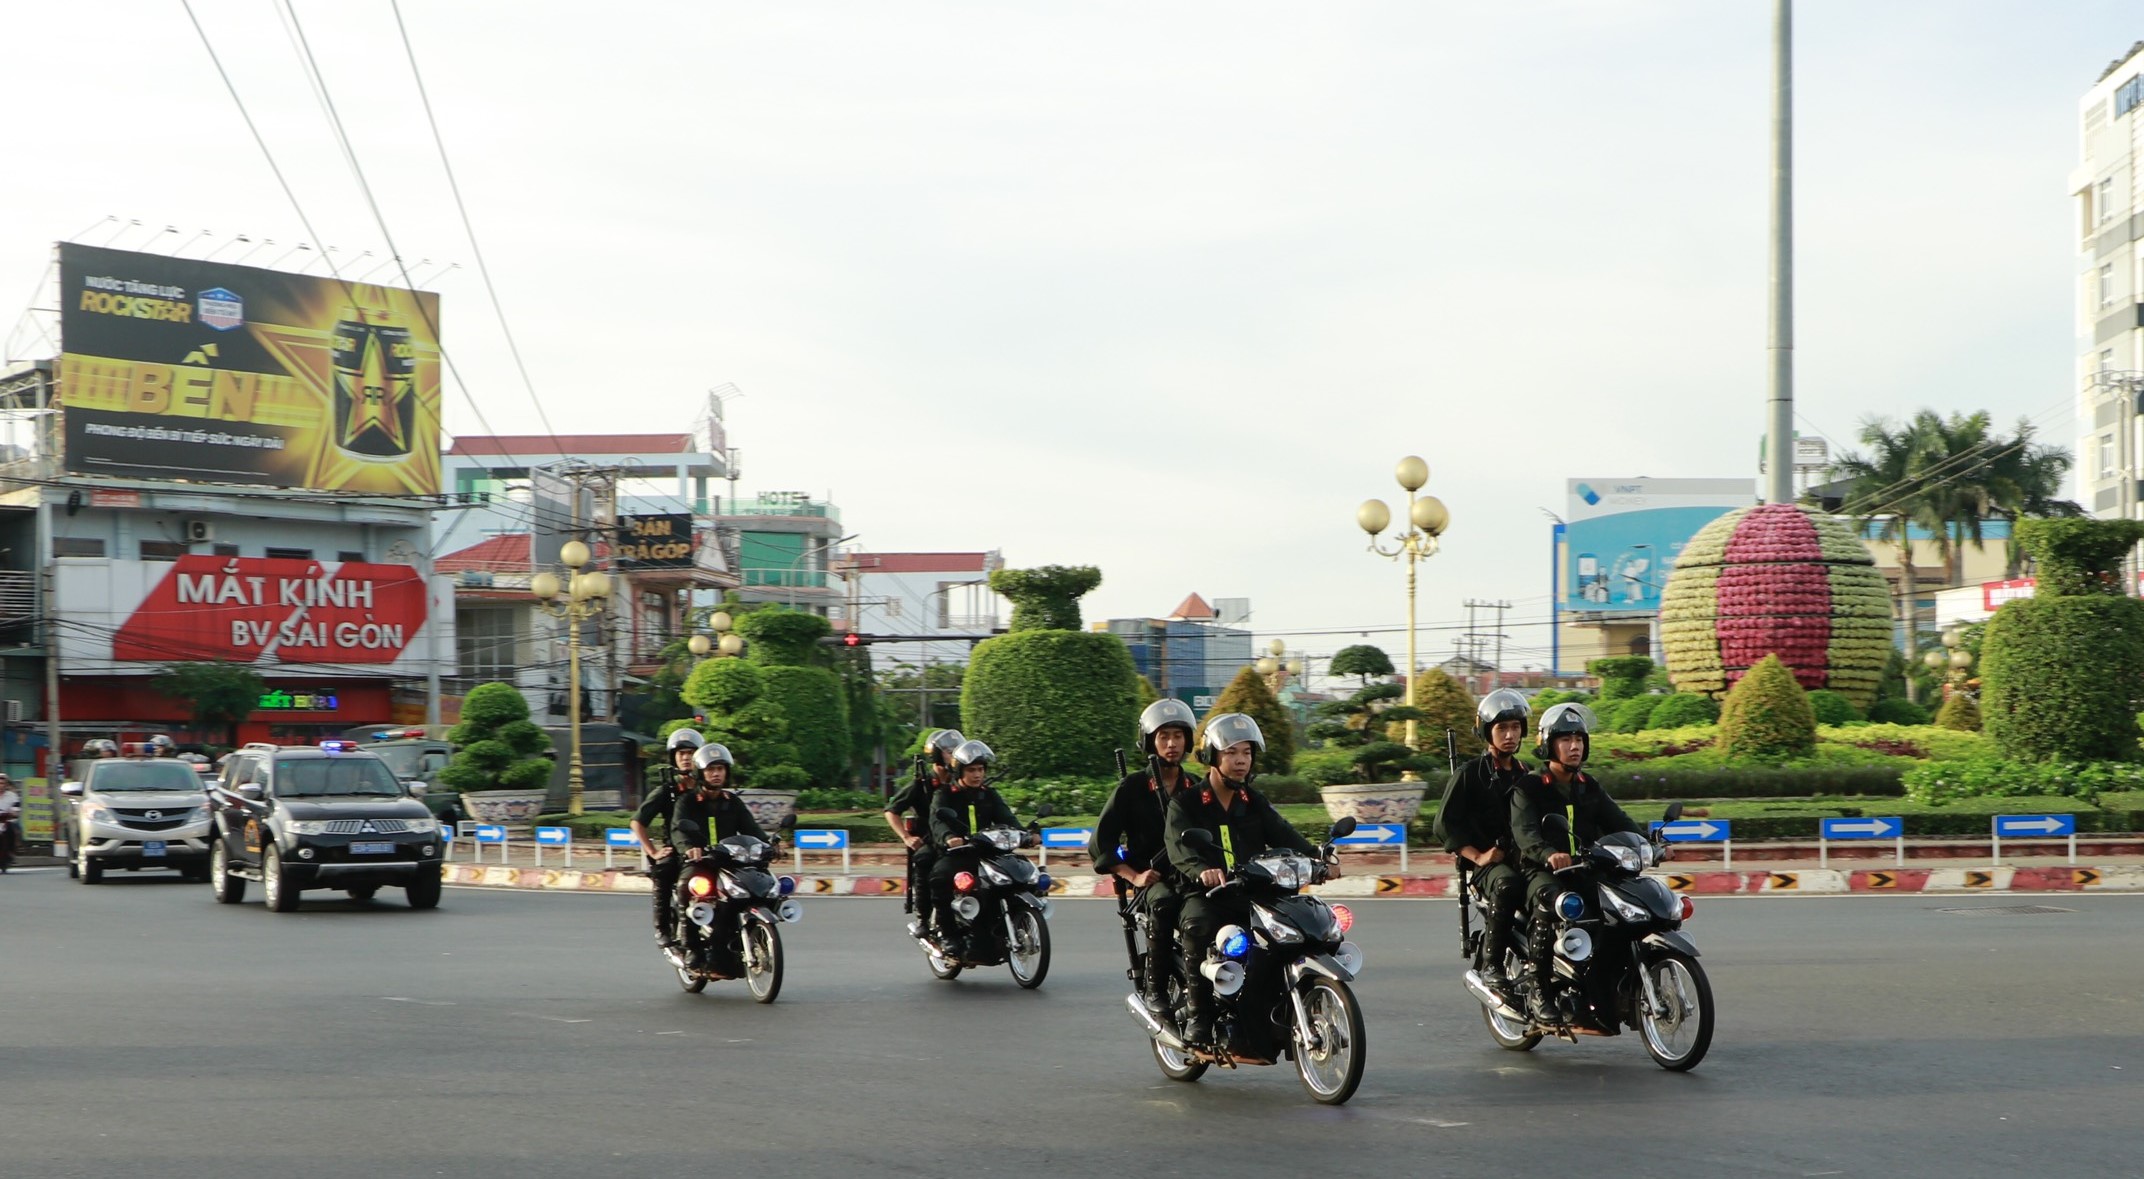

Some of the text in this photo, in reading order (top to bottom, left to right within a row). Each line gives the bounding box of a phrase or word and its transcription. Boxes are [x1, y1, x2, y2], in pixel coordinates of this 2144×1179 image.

[80, 290, 193, 323] ROCKSTAR
[650, 540, 691, 559] GÓP
[177, 558, 373, 608] MẮT KÍNH
[231, 613, 403, 648] BV SÀI GÒN
